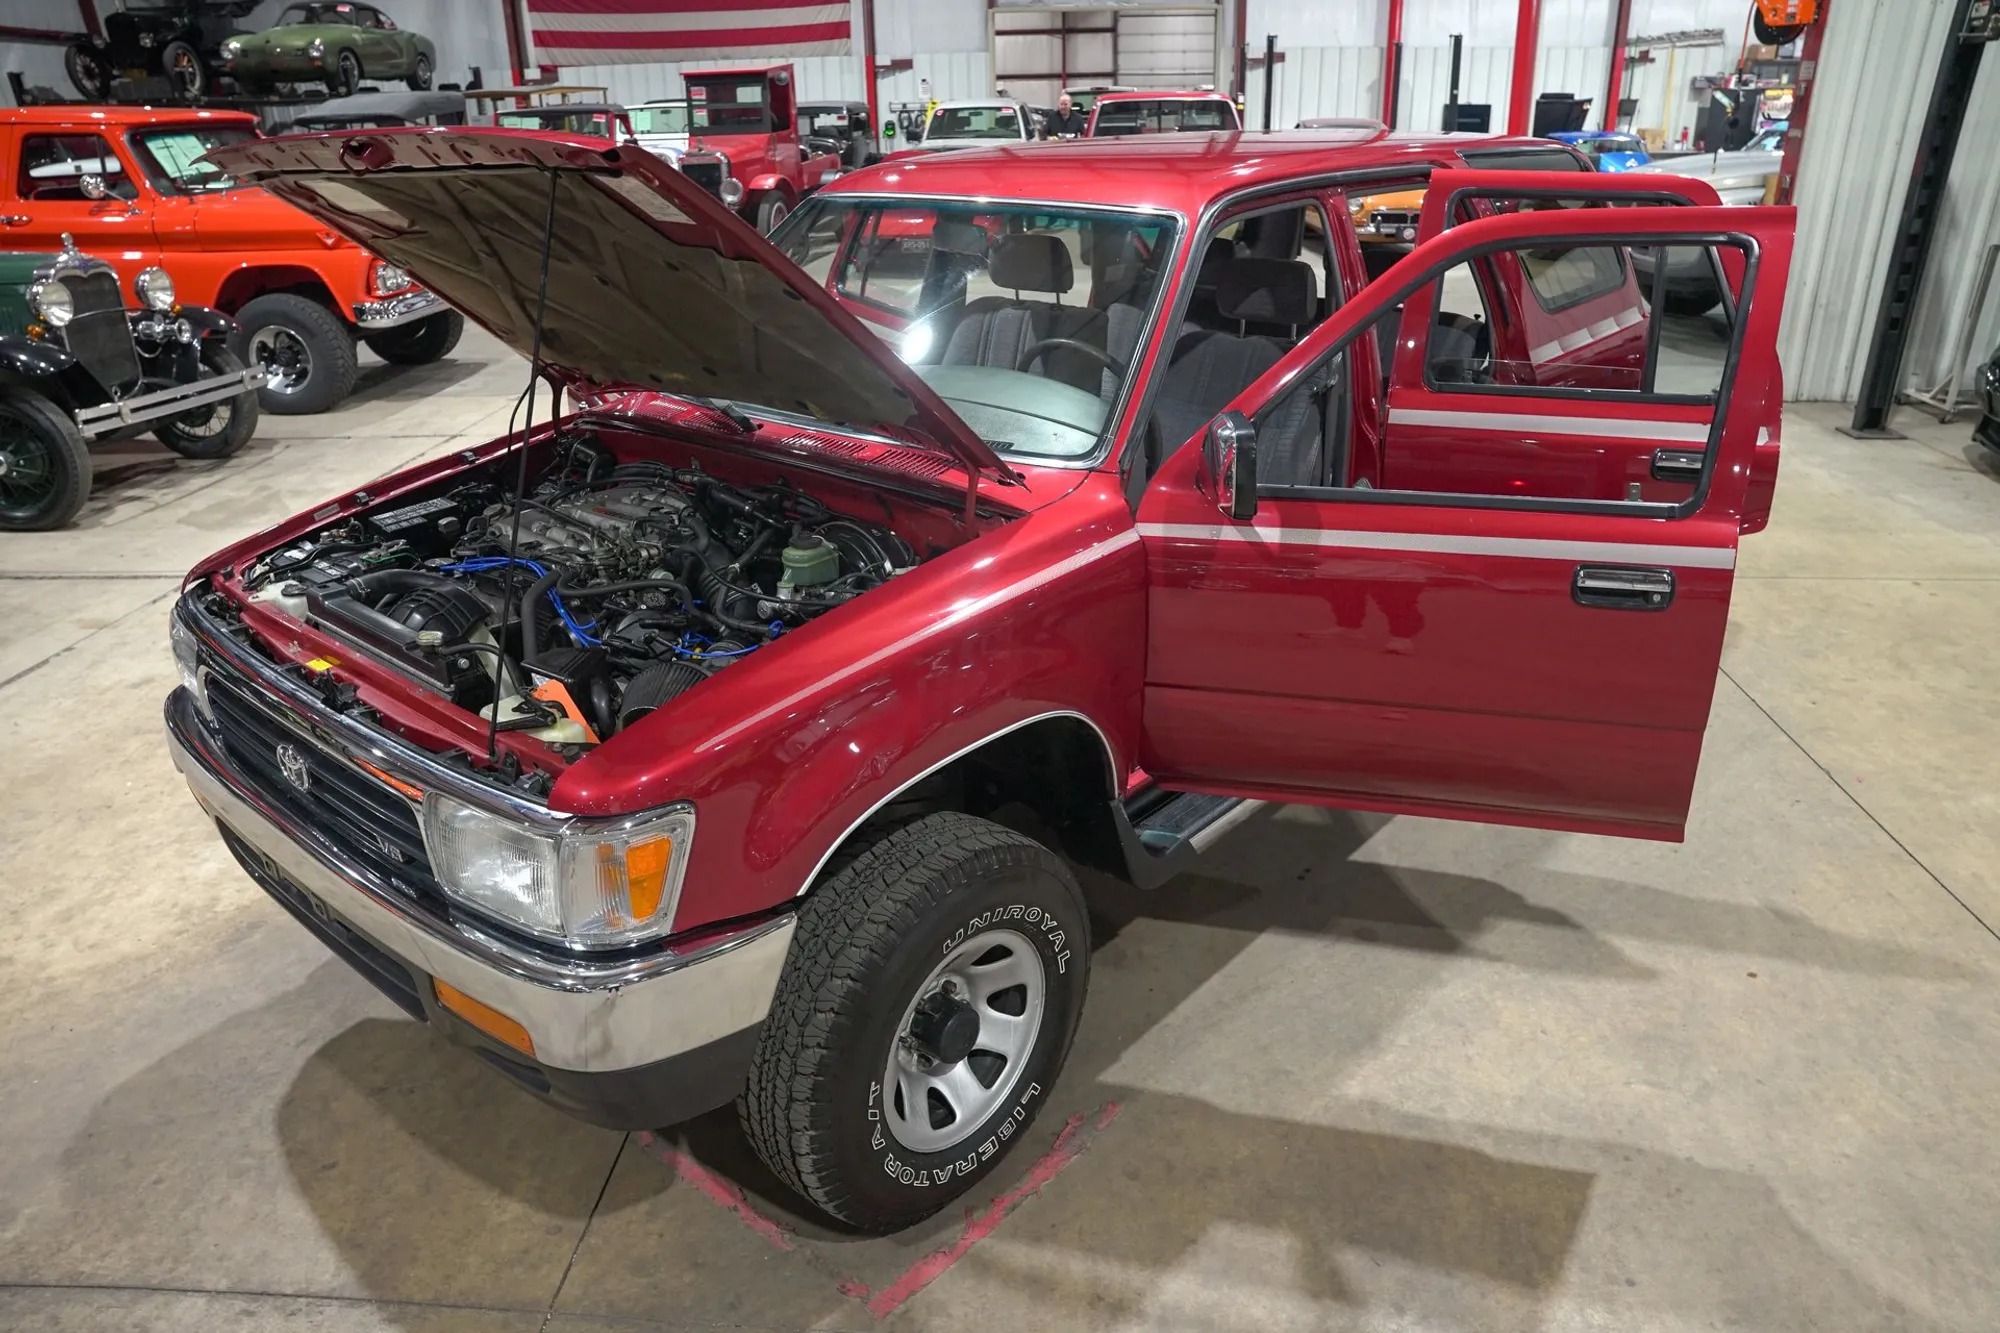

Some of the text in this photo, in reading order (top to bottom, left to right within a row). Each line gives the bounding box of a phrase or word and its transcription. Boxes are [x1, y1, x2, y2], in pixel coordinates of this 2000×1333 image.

[376, 836, 403, 862] V6
[943, 905, 1072, 974] UNIROYAL
[884, 1082, 1041, 1187] LIBERATOR
